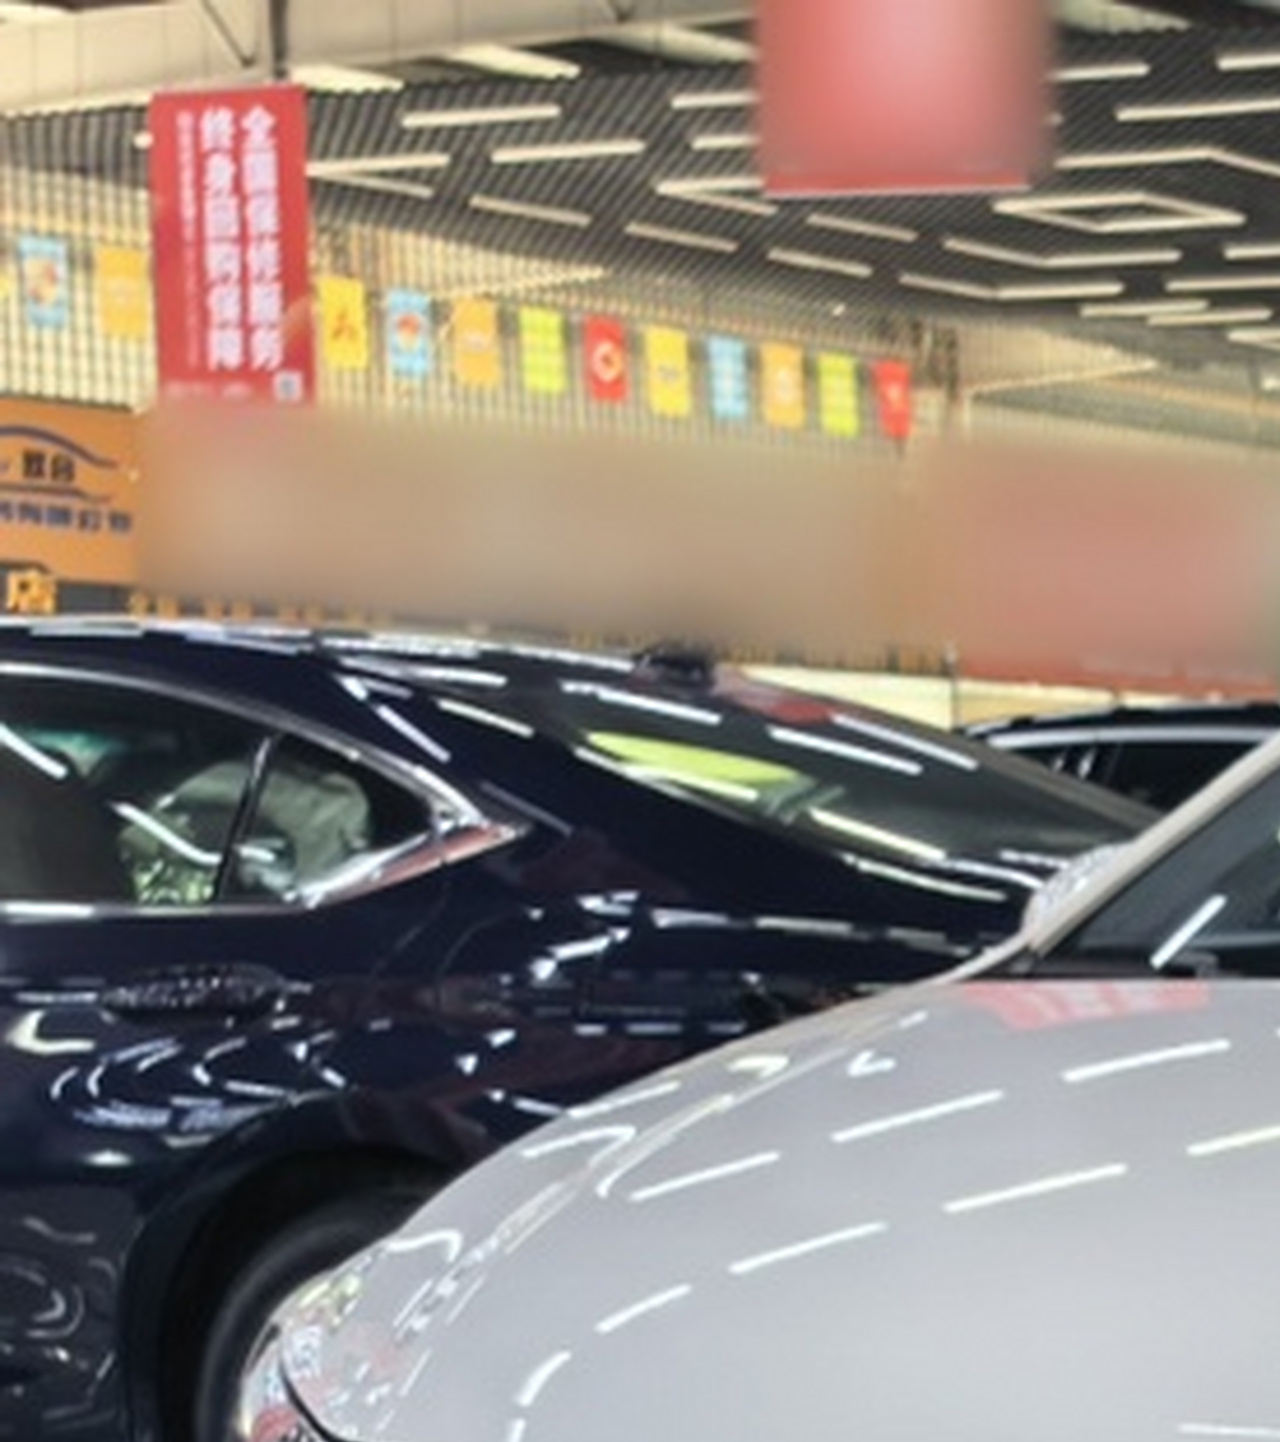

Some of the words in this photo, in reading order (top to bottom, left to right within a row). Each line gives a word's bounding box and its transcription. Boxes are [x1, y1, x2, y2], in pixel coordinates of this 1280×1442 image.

[199, 105, 244, 371] 终身回购保障
[239, 104, 284, 371] 全国保修服务
